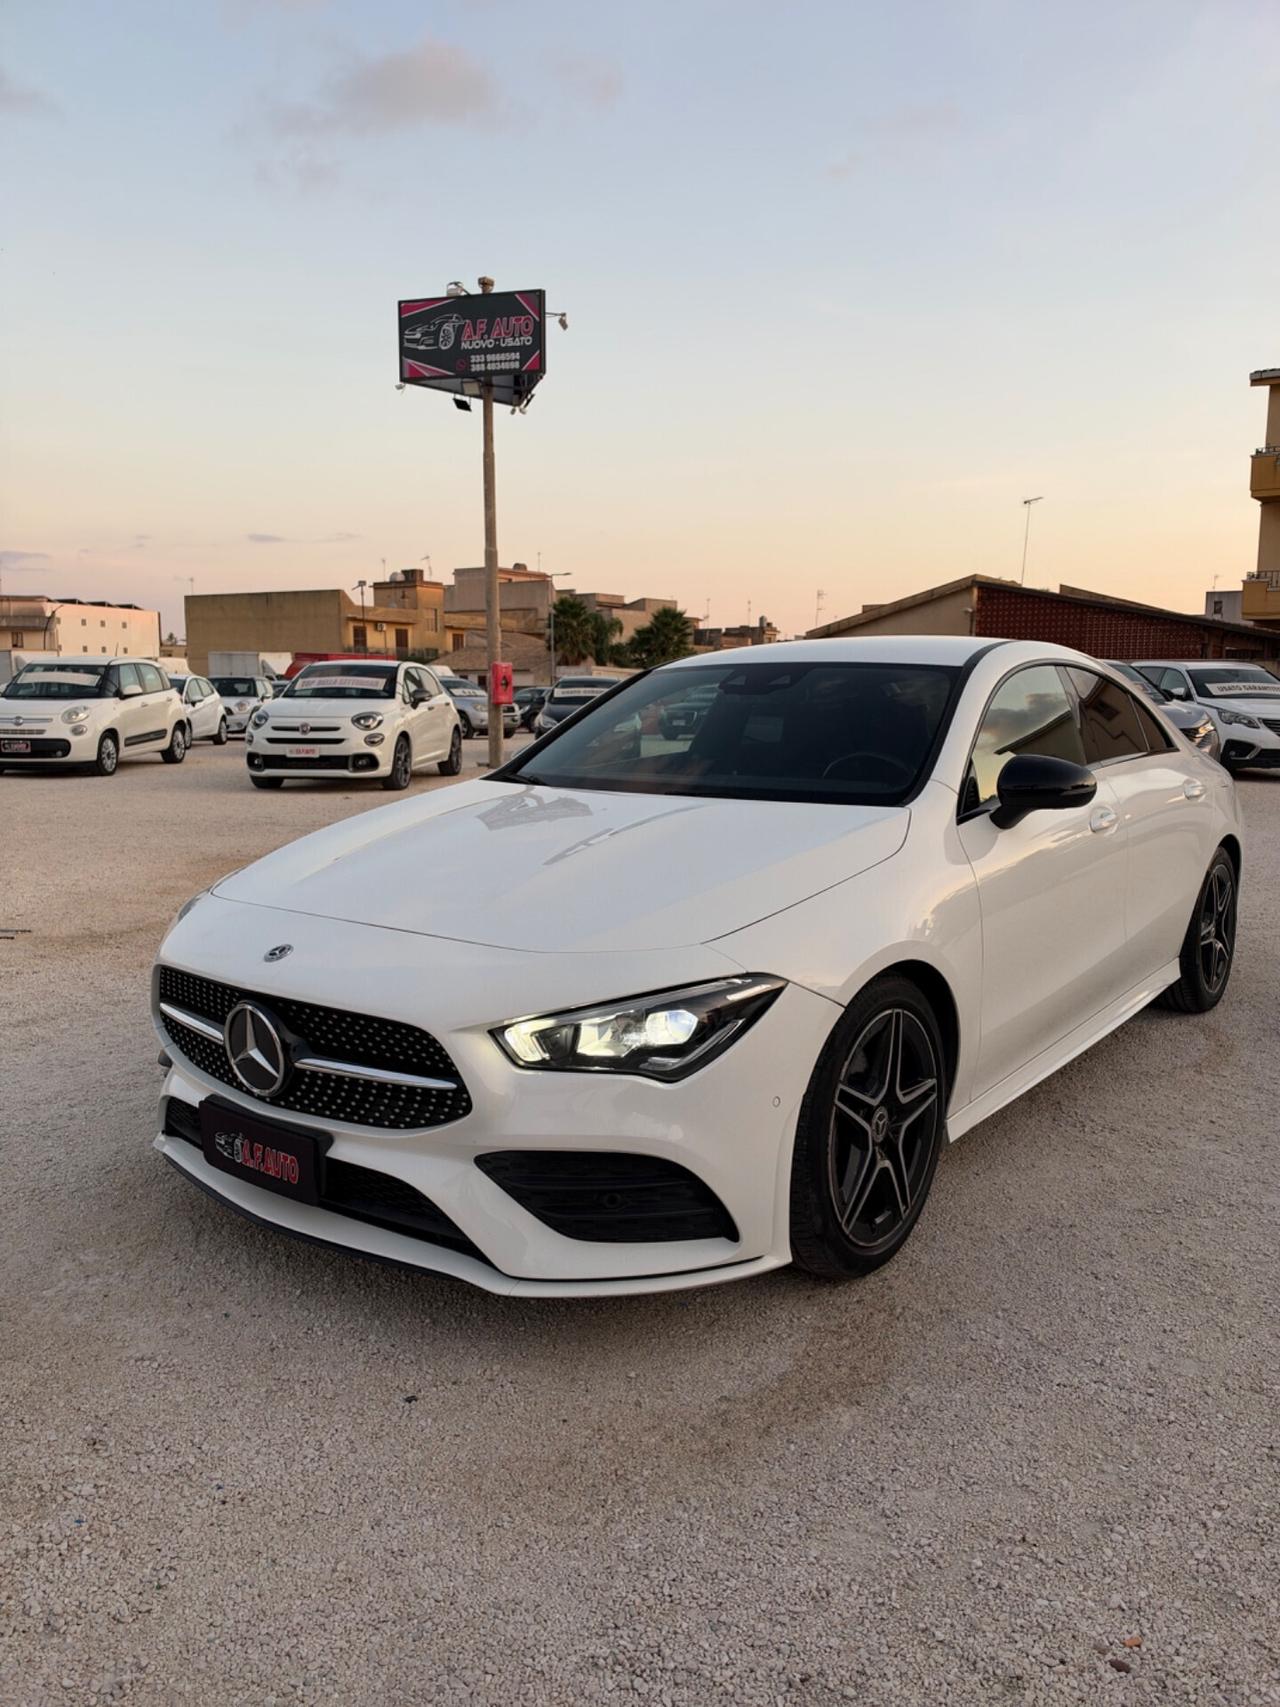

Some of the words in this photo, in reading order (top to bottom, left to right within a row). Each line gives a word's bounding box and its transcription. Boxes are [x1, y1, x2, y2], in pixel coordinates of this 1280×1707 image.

[490, 315, 534, 338] AUTO
[461, 339, 495, 350] NUOVO
[500, 336, 533, 347] USATO
